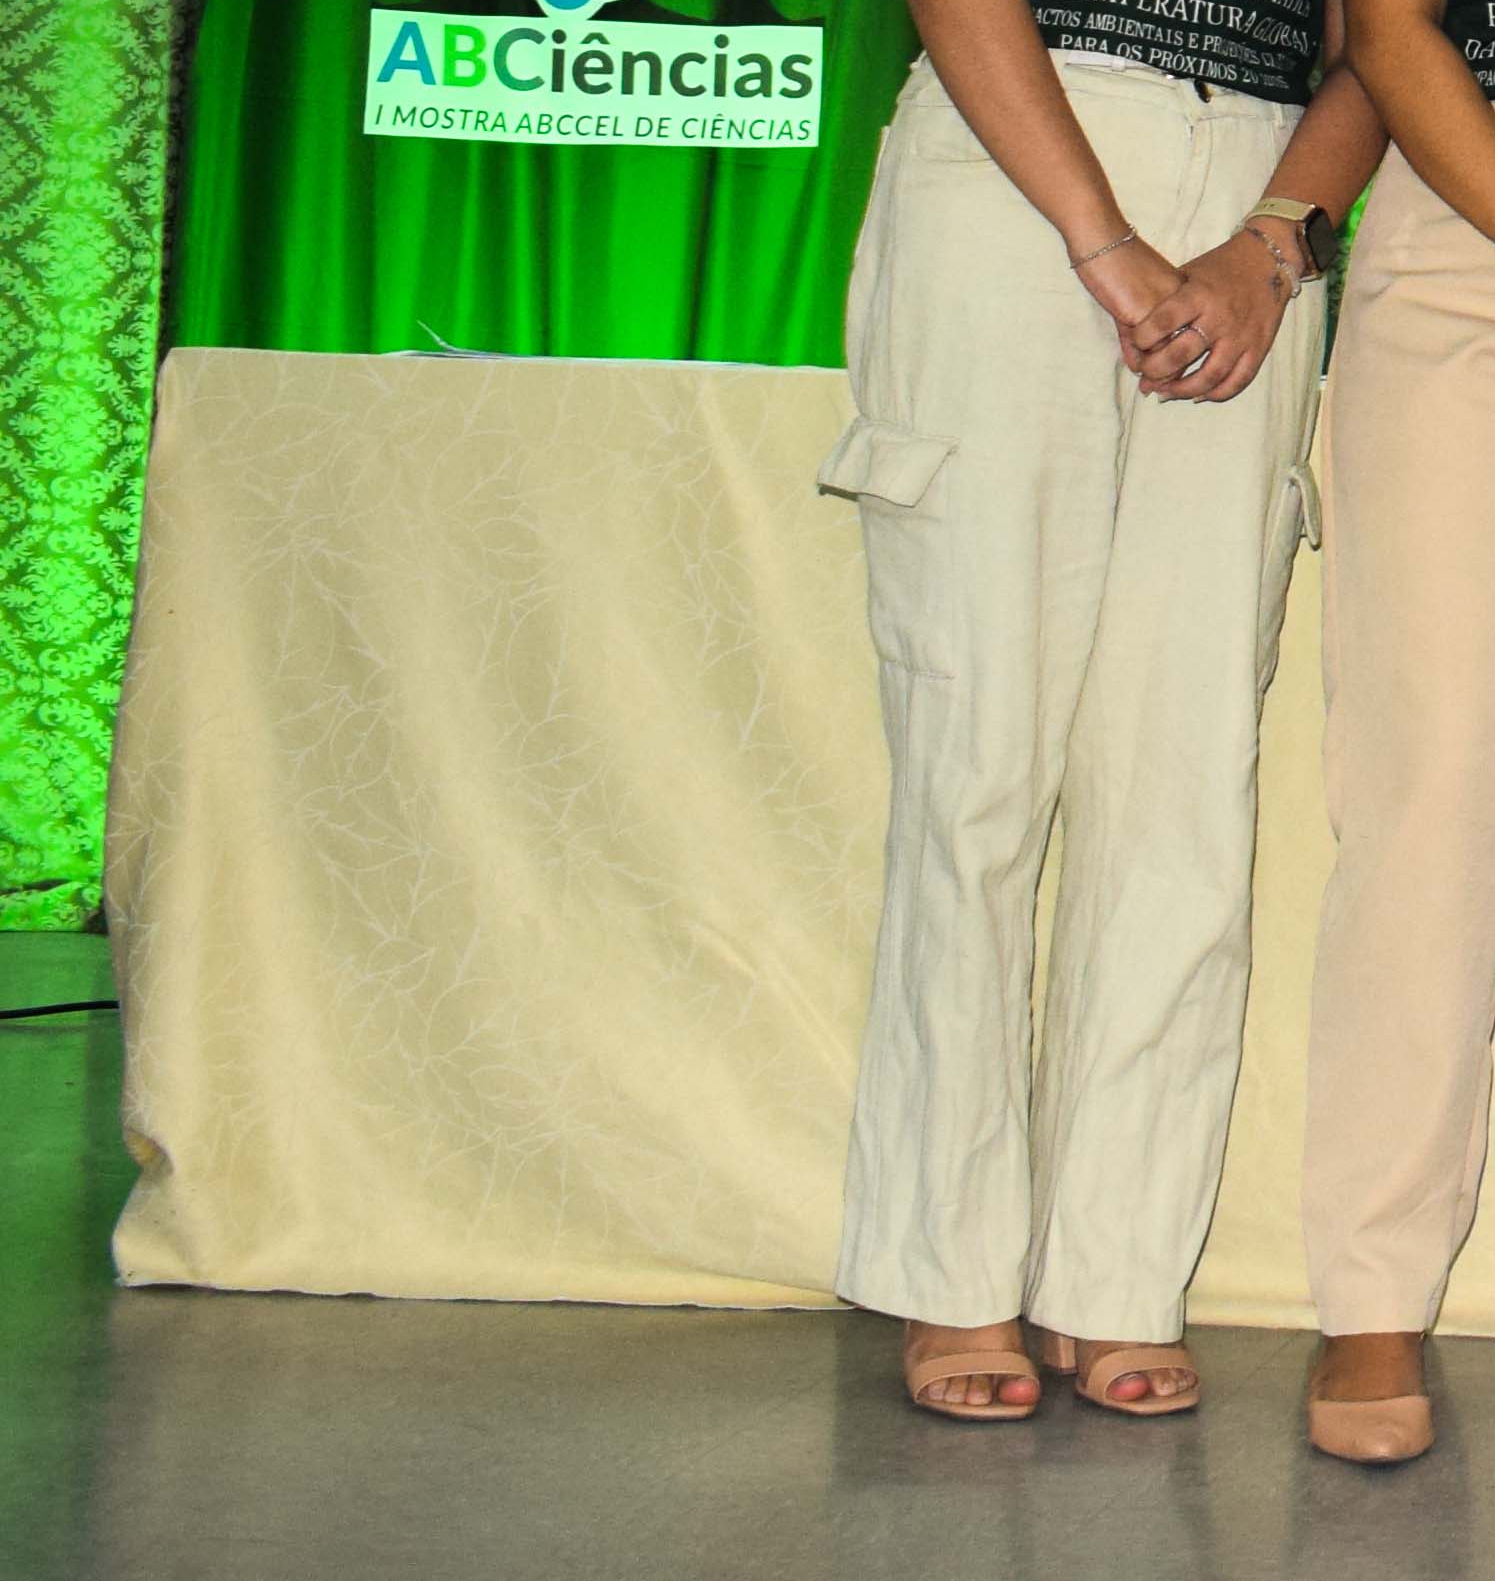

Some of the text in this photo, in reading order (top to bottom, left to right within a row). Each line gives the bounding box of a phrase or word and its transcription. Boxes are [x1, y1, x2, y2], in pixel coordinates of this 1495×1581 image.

[1083, 12, 1185, 47] AMBIENTAIS
[1188, 32, 1200, 49] E
[376, 20, 814, 100] ABCiências
[1149, 47, 1238, 82] PRÓXIMOS
[374, 103, 812, 141] I MOSTRA ABCCEL DE CIÊNCIAS
